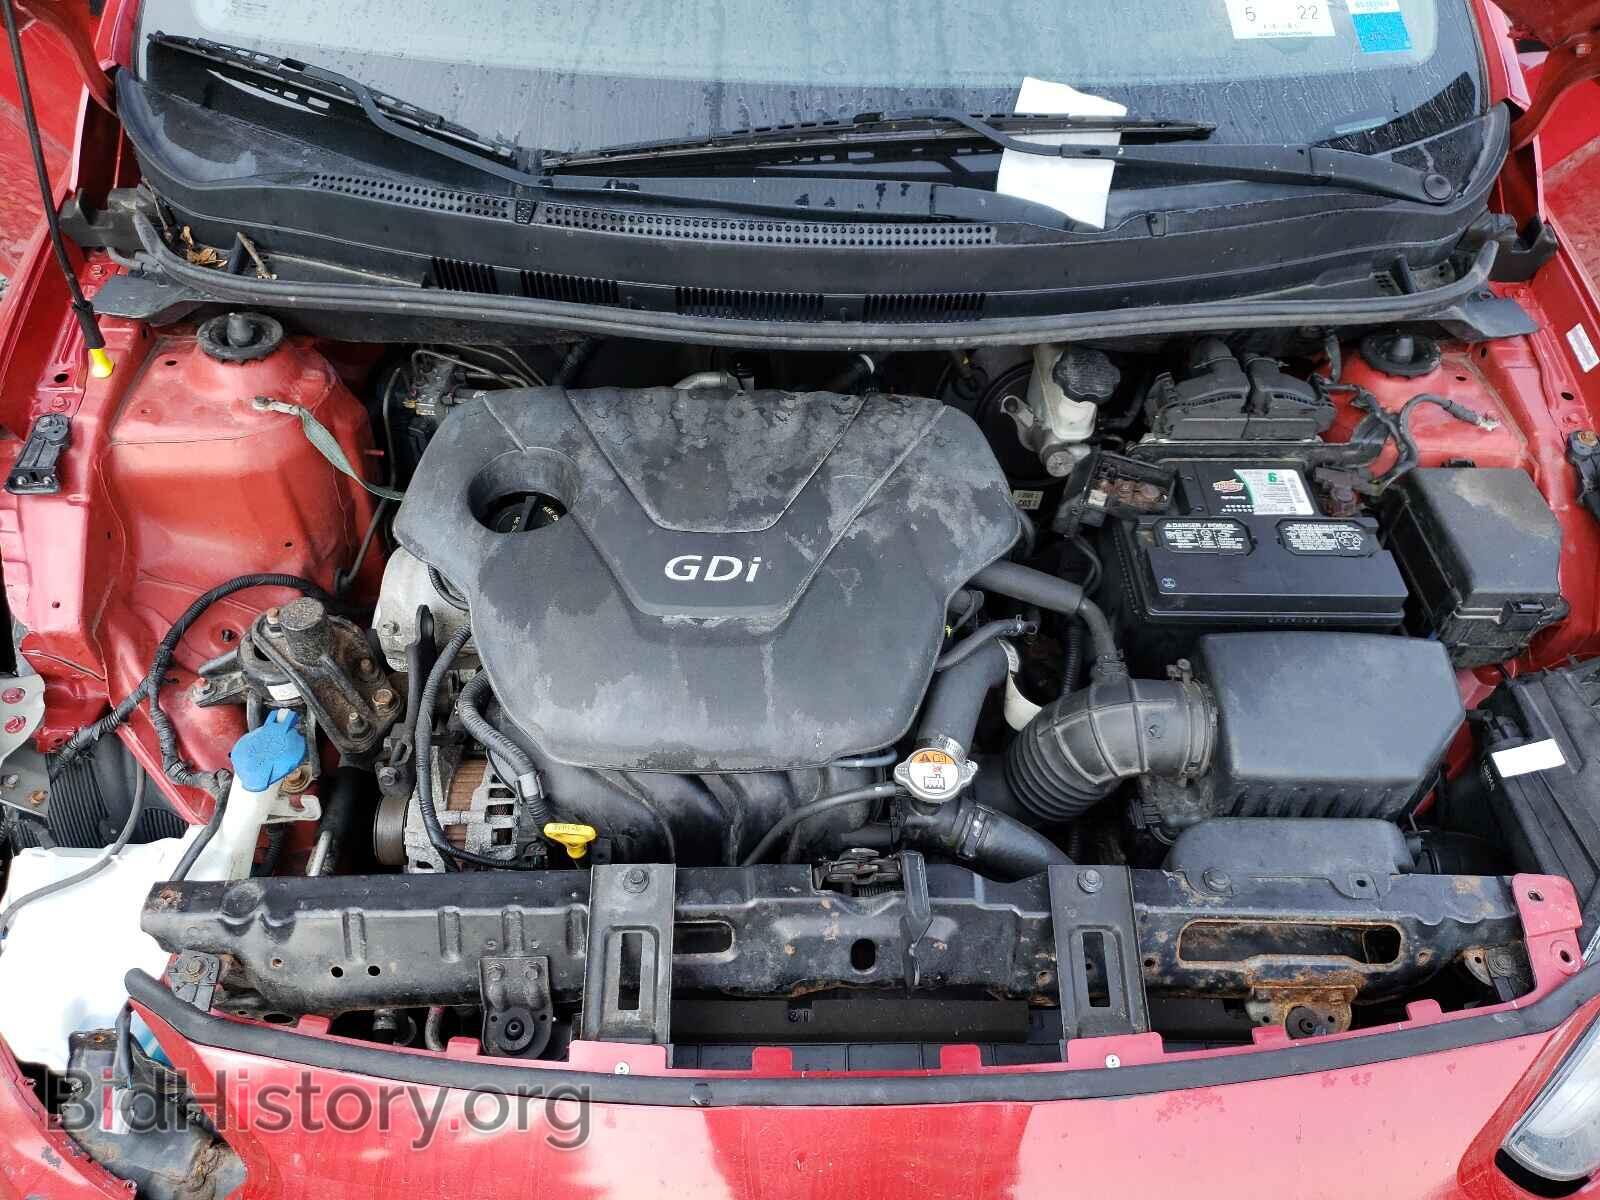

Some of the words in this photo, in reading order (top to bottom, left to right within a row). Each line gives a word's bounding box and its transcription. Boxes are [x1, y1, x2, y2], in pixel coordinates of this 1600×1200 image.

[1298, 5, 1319, 21] 22
[1267, 472, 1278, 483] 6
[664, 554, 762, 582] GDi
